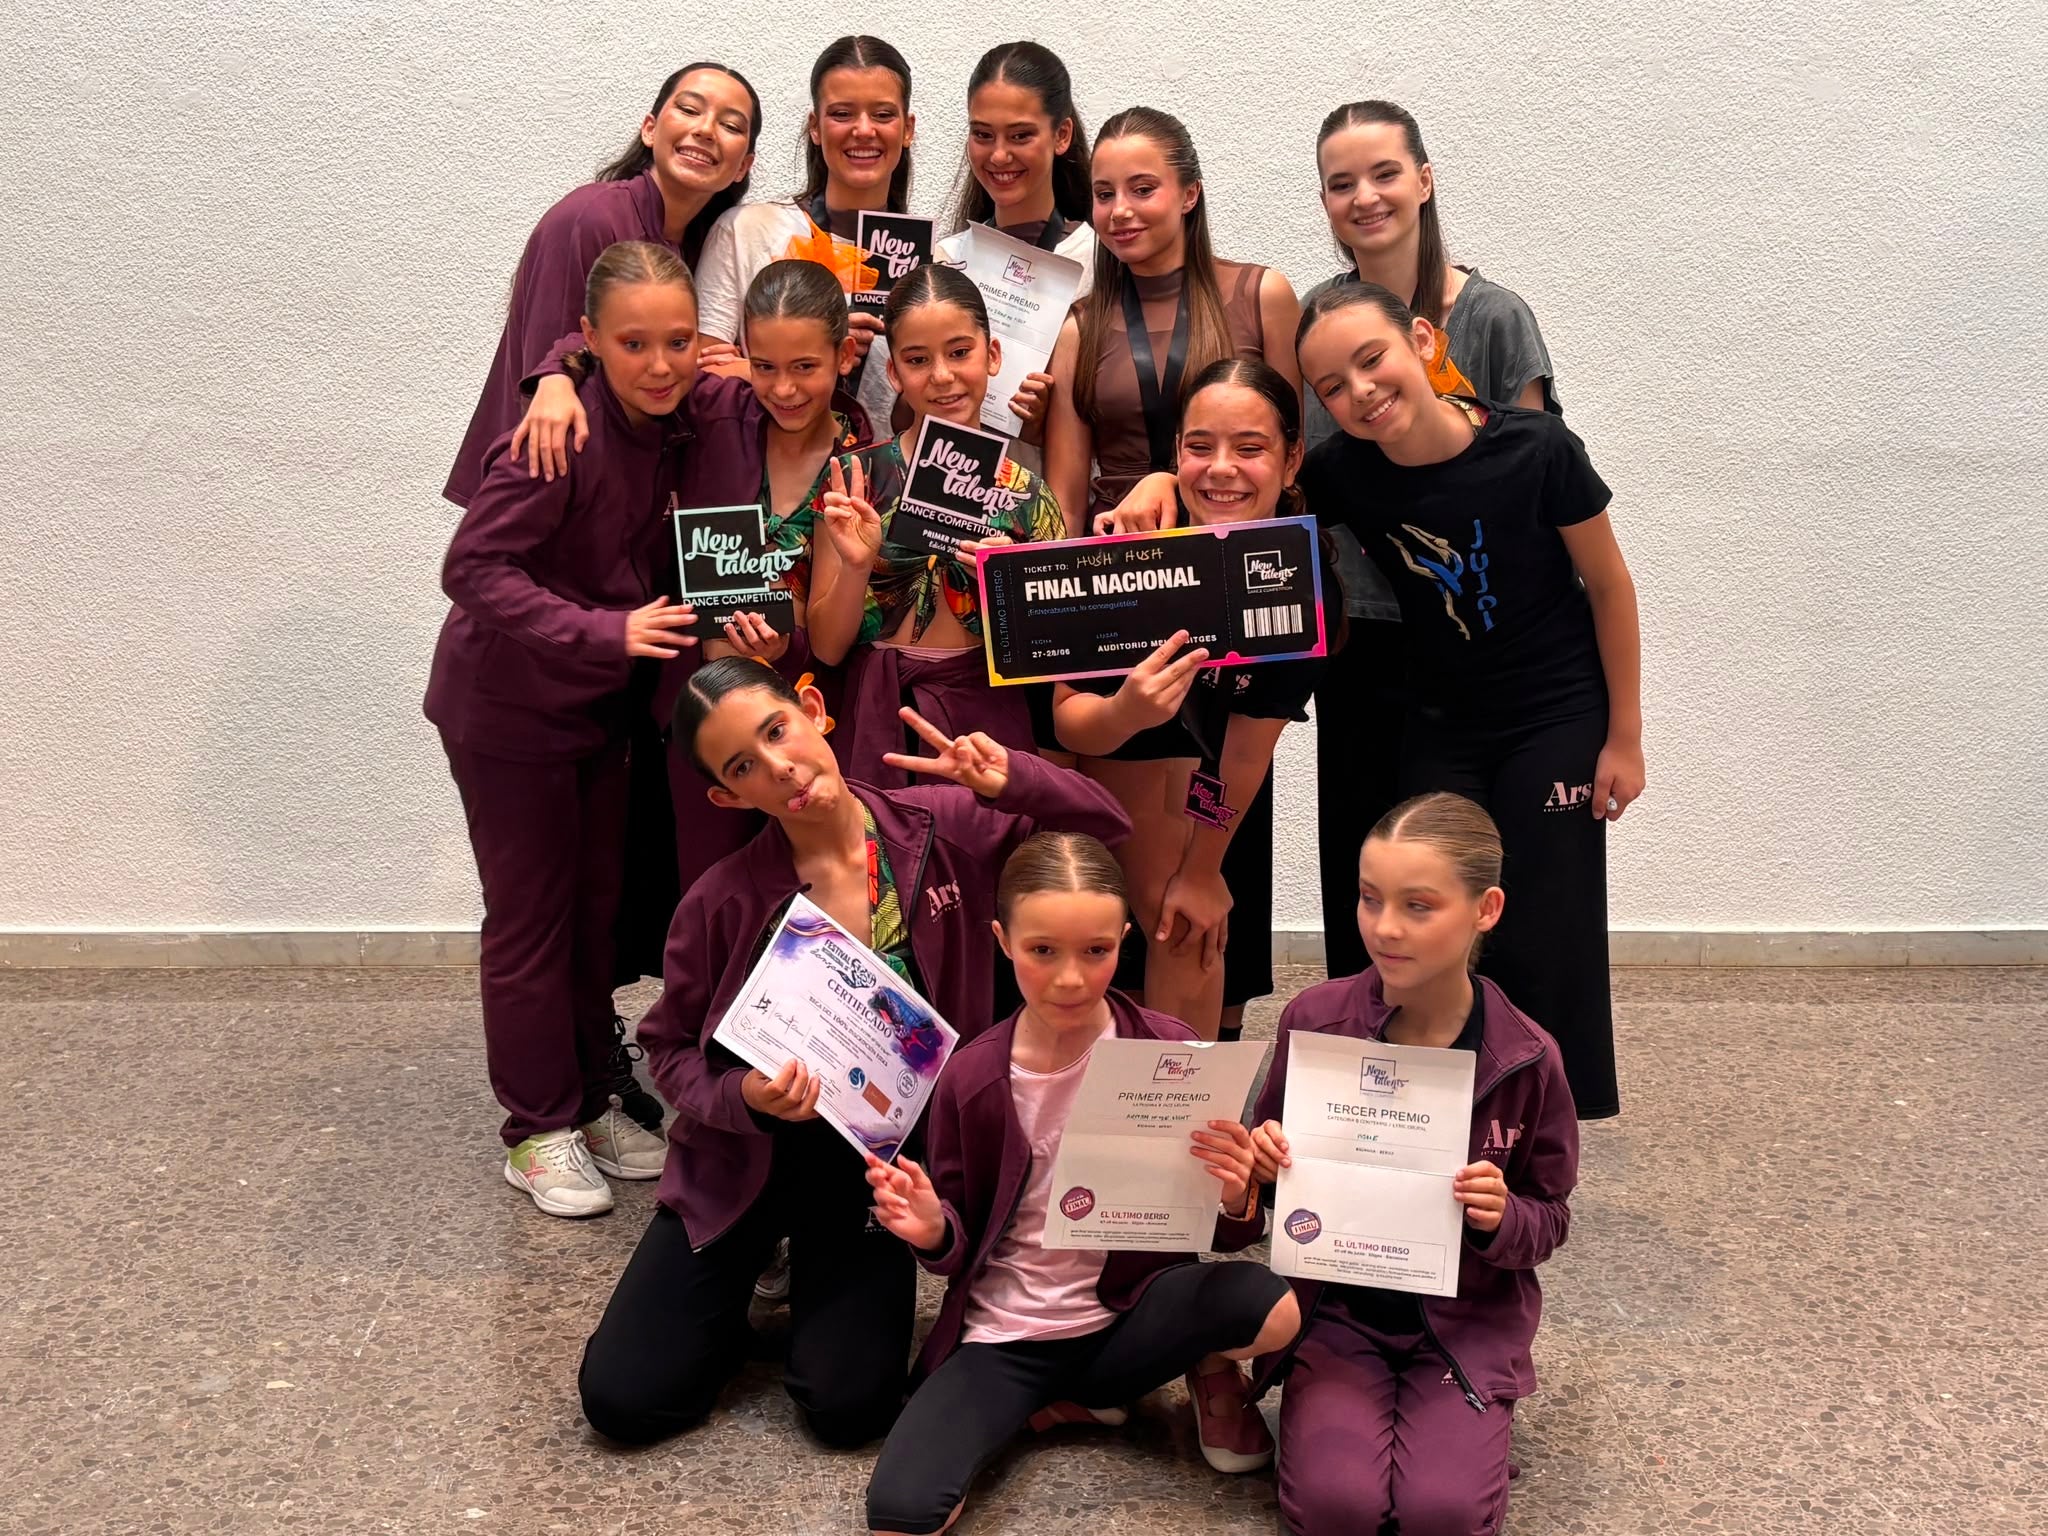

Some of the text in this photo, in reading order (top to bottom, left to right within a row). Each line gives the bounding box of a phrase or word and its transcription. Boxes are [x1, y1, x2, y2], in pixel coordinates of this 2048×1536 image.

[864, 229, 915, 261] New
[855, 294, 888, 306] DANCE
[978, 282, 1008, 298] PRIMER
[1009, 294, 1040, 311] PREMIO
[919, 438, 980, 474] New
[942, 468, 1031, 518] talents
[900, 503, 1006, 538] DANCE COMPETITION
[684, 526, 742, 560] New
[922, 529, 950, 542] PRIMER
[716, 547, 803, 581] talents
[1024, 565, 1052, 574] TICKET
[1076, 548, 1164, 568] HUSH HUSH
[1248, 560, 1272, 574] New
[1024, 566, 1200, 602] FINAL NACIONAL
[1260, 566, 1298, 582] talents
[683, 590, 792, 607] DANCE COMPETITION
[994, 570, 1006, 606] BERSO
[1097, 641, 1148, 652] AUDITORIO
[1544, 782, 1592, 806] Ars
[926, 880, 960, 917] Ars
[824, 939, 852, 964] FESTIVAL
[828, 979, 892, 1038] CERTIFICADO
[1364, 1064, 1386, 1076] New
[1118, 1092, 1210, 1102] PRIMER PREMIO
[1326, 1102, 1430, 1124] TERCER PREMIO
[1144, 1212, 1170, 1220] BERSO
[1334, 1240, 1344, 1248] EL
[1381, 1245, 1410, 1255] BERSO
